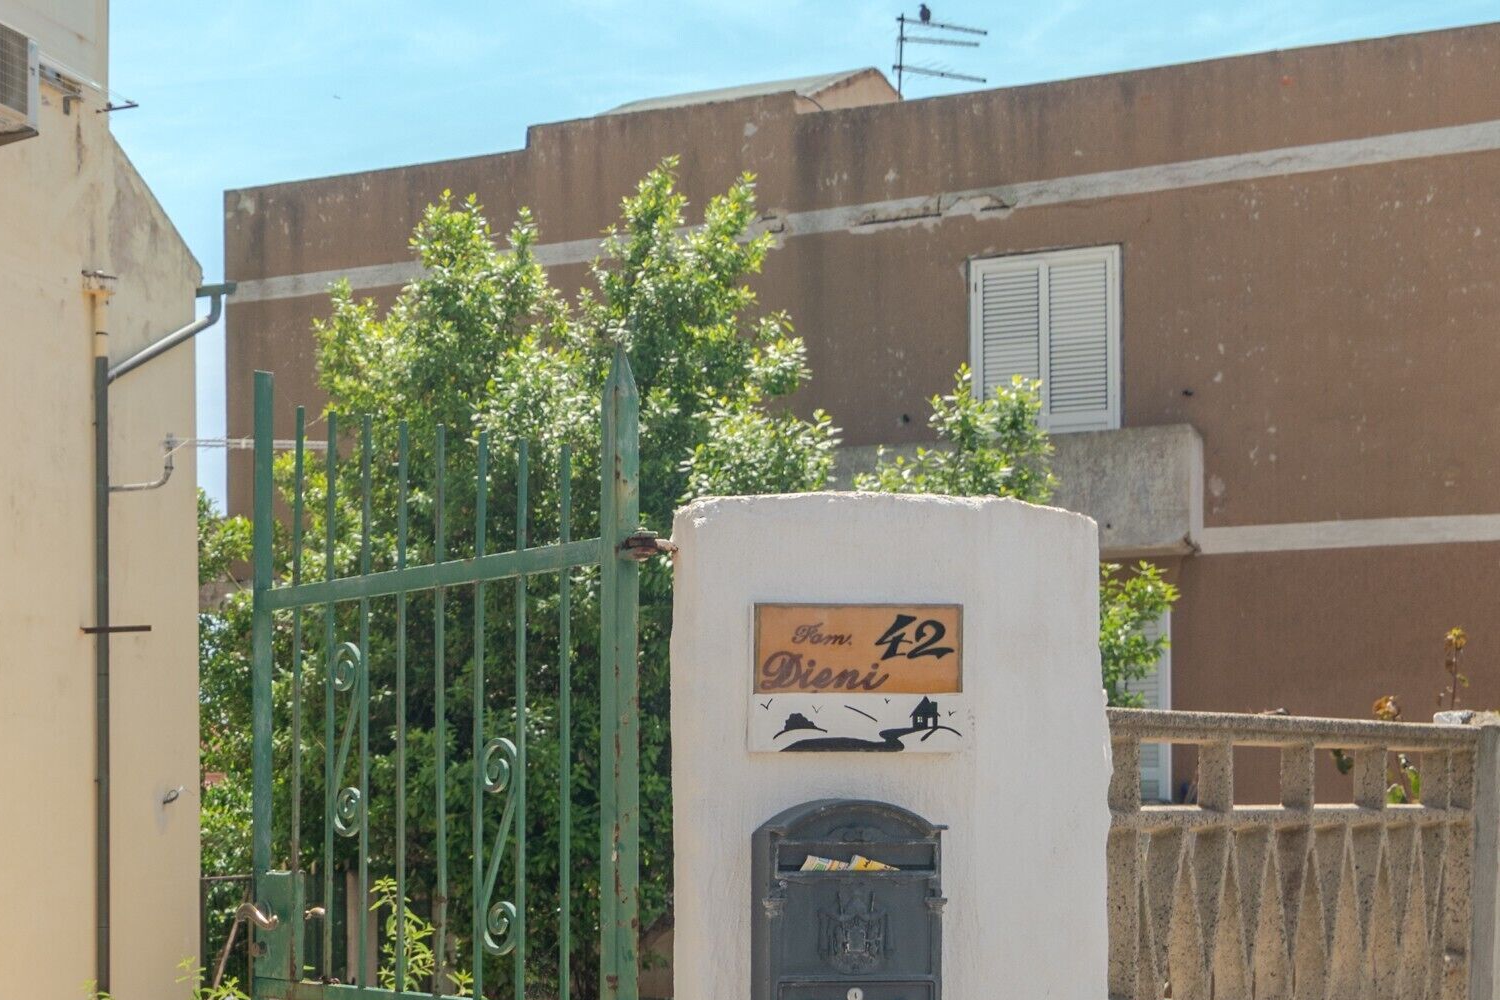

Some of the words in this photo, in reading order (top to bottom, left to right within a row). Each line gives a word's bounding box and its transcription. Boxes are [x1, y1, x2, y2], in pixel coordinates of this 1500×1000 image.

[792, 622, 852, 645] Fam.
[875, 614, 954, 660] 42
[761, 651, 889, 690] Dieni
